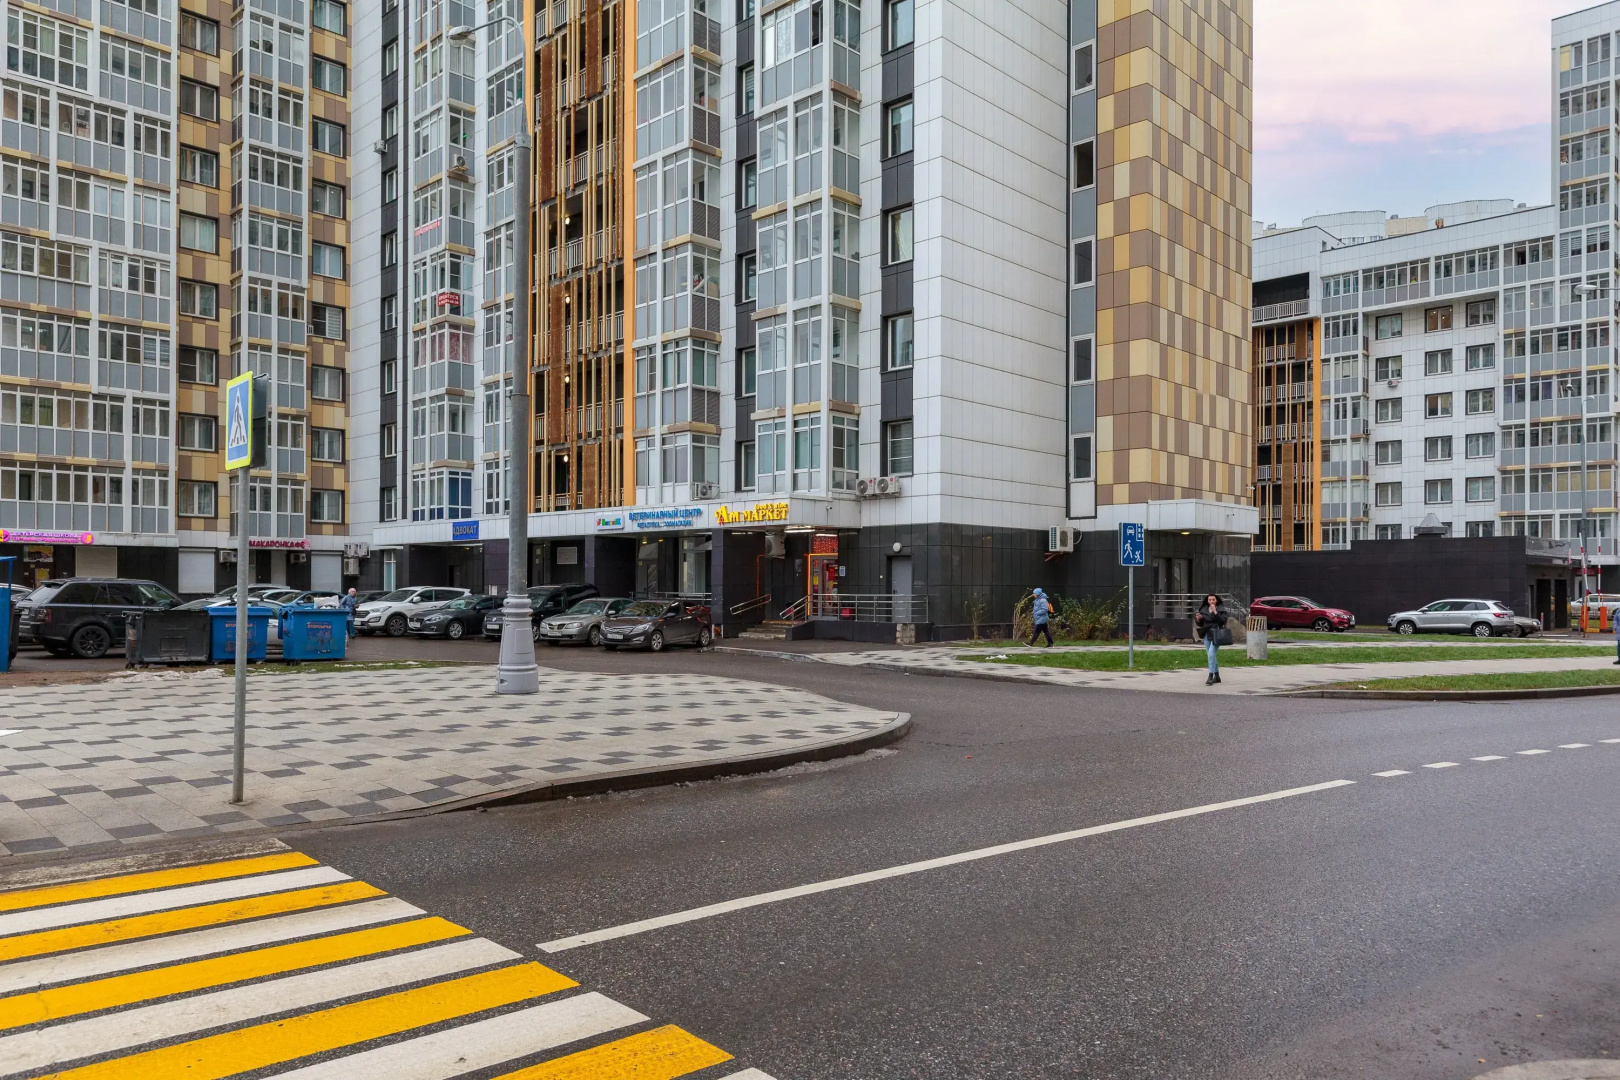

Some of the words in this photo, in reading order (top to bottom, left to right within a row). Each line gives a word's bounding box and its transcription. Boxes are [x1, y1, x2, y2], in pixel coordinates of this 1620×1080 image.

[629, 508, 679, 521] ВЕТЕРИНАРНЫЙ
[680, 508, 702, 519] ЦЕНТР
[742, 508, 789, 521] МАРКЕТ
